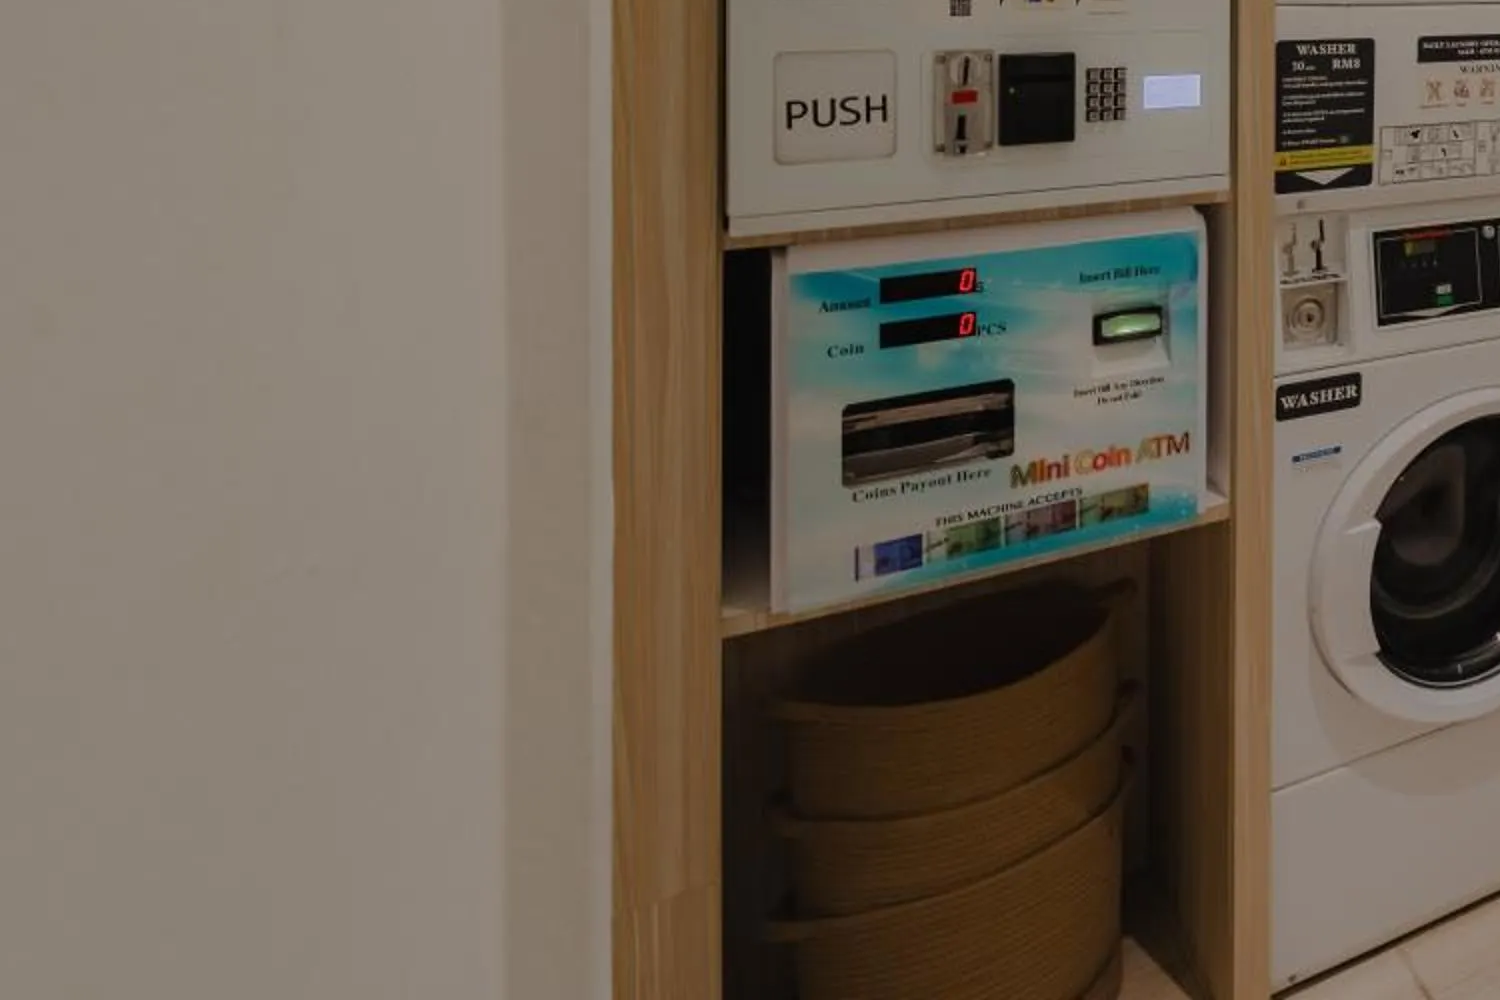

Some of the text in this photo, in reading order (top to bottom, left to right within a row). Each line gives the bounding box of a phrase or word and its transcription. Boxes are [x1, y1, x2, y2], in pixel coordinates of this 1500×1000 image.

[1295, 43, 1359, 56] WASHER
[1332, 58, 1361, 71] RM8
[785, 94, 888, 130] PUSH
[958, 268, 975, 293] 0
[958, 312, 975, 337] 0
[827, 343, 865, 359] Coin
[1279, 383, 1360, 411] WASHER
[1010, 431, 1191, 489] Mini Coin ATM
[852, 467, 993, 503] Coins Payout Here
[935, 487, 1084, 528] THIS MACHINE ACCEPTS
